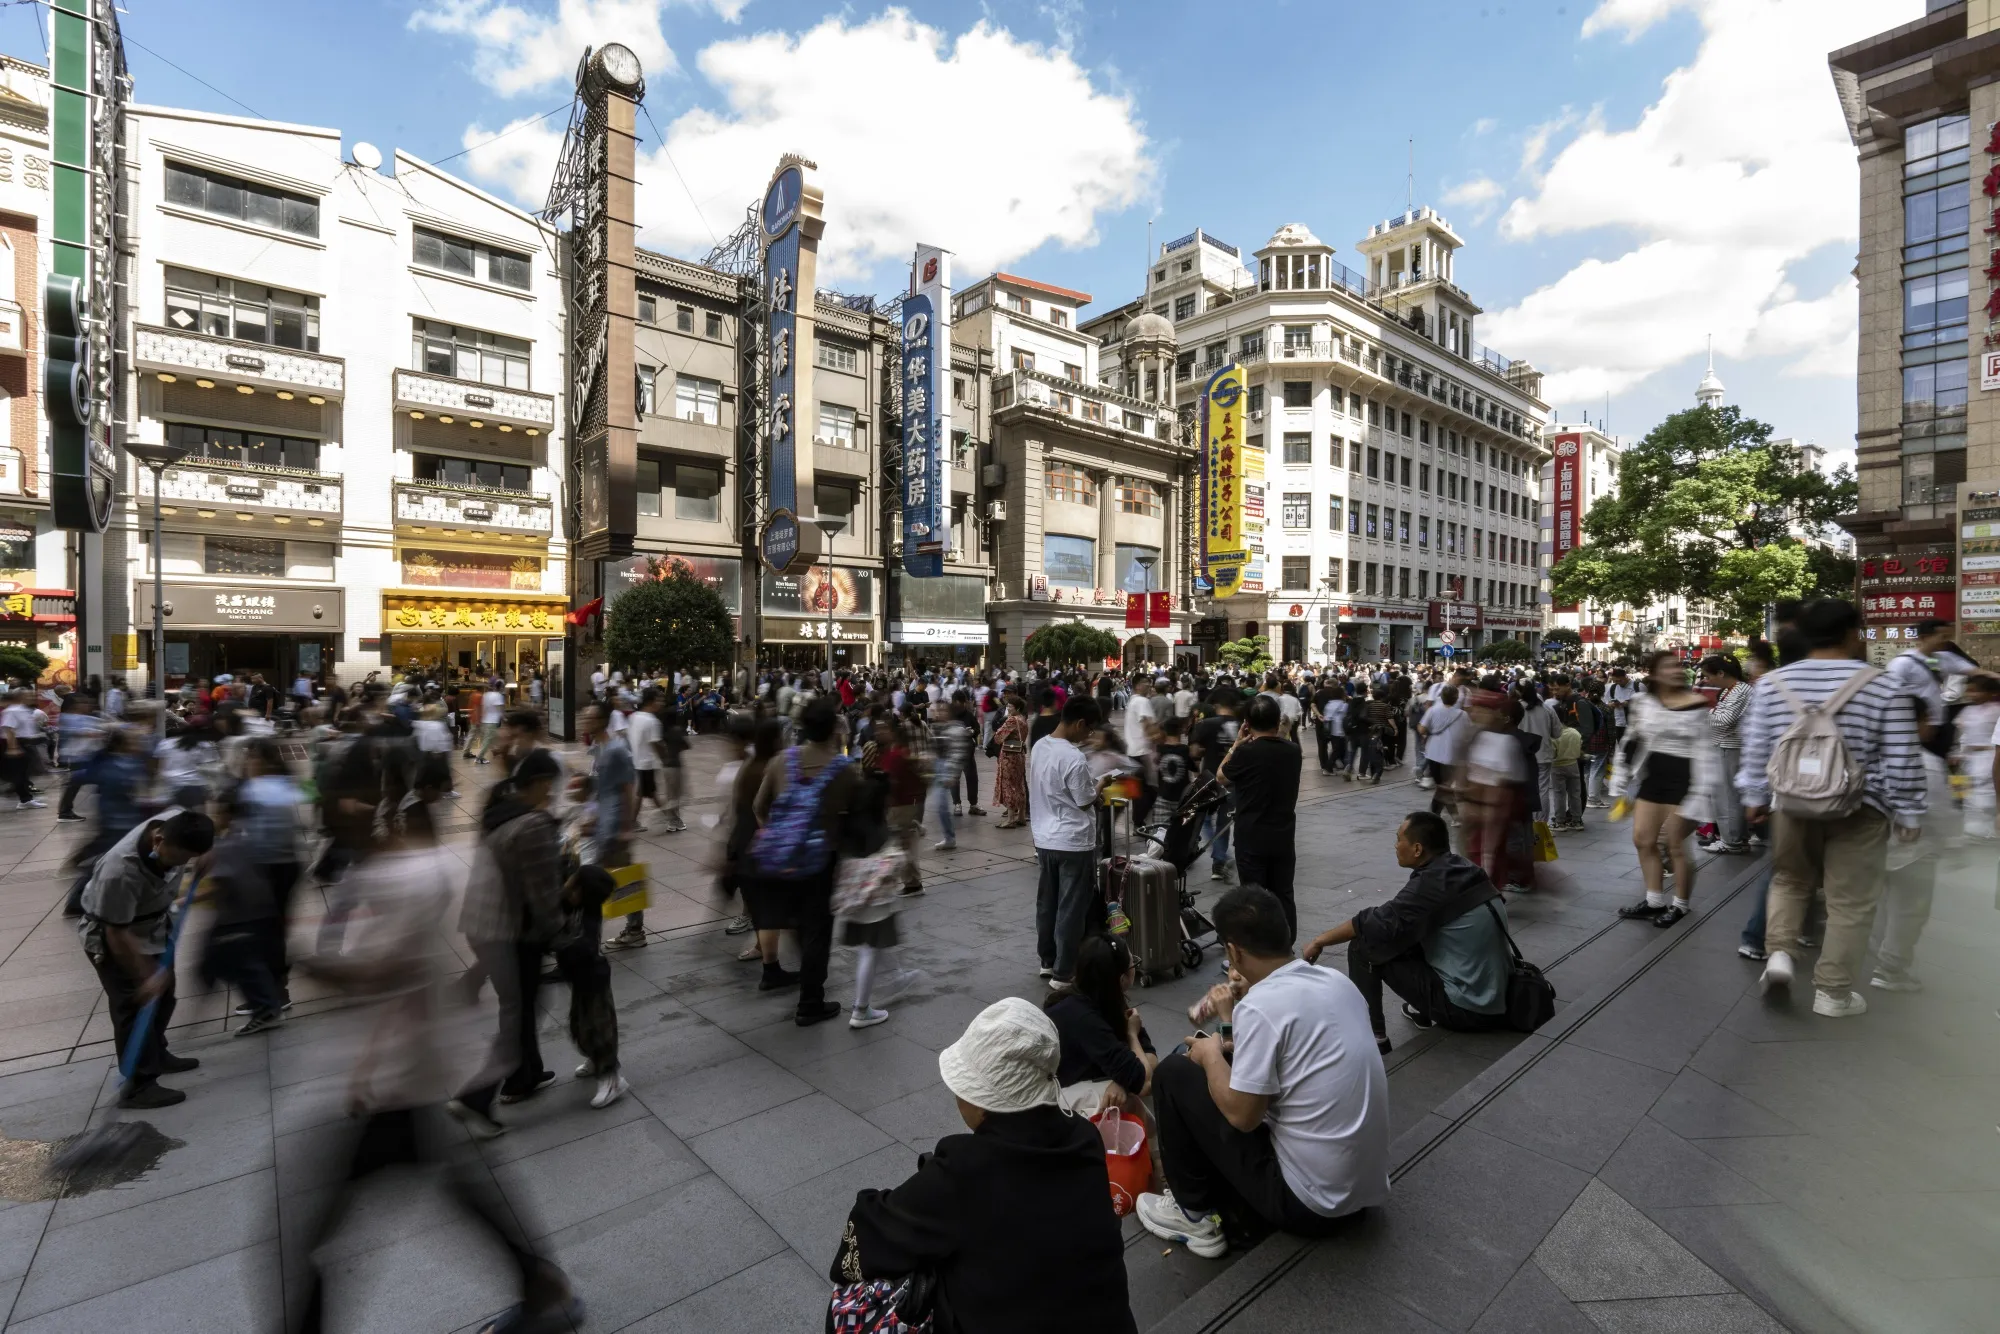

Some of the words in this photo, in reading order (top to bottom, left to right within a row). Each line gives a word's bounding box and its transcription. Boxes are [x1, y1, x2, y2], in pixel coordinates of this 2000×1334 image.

[906, 356, 926, 506] 华美大药房
[1560, 461, 1573, 550] 上海市第一食品商店
[620, 571, 645, 579] Hennessy
[1886, 576, 1913, 584] 营业时间
[1865, 596, 1936, 610] 新雅食品
[1886, 628, 1918, 639] 汤包
